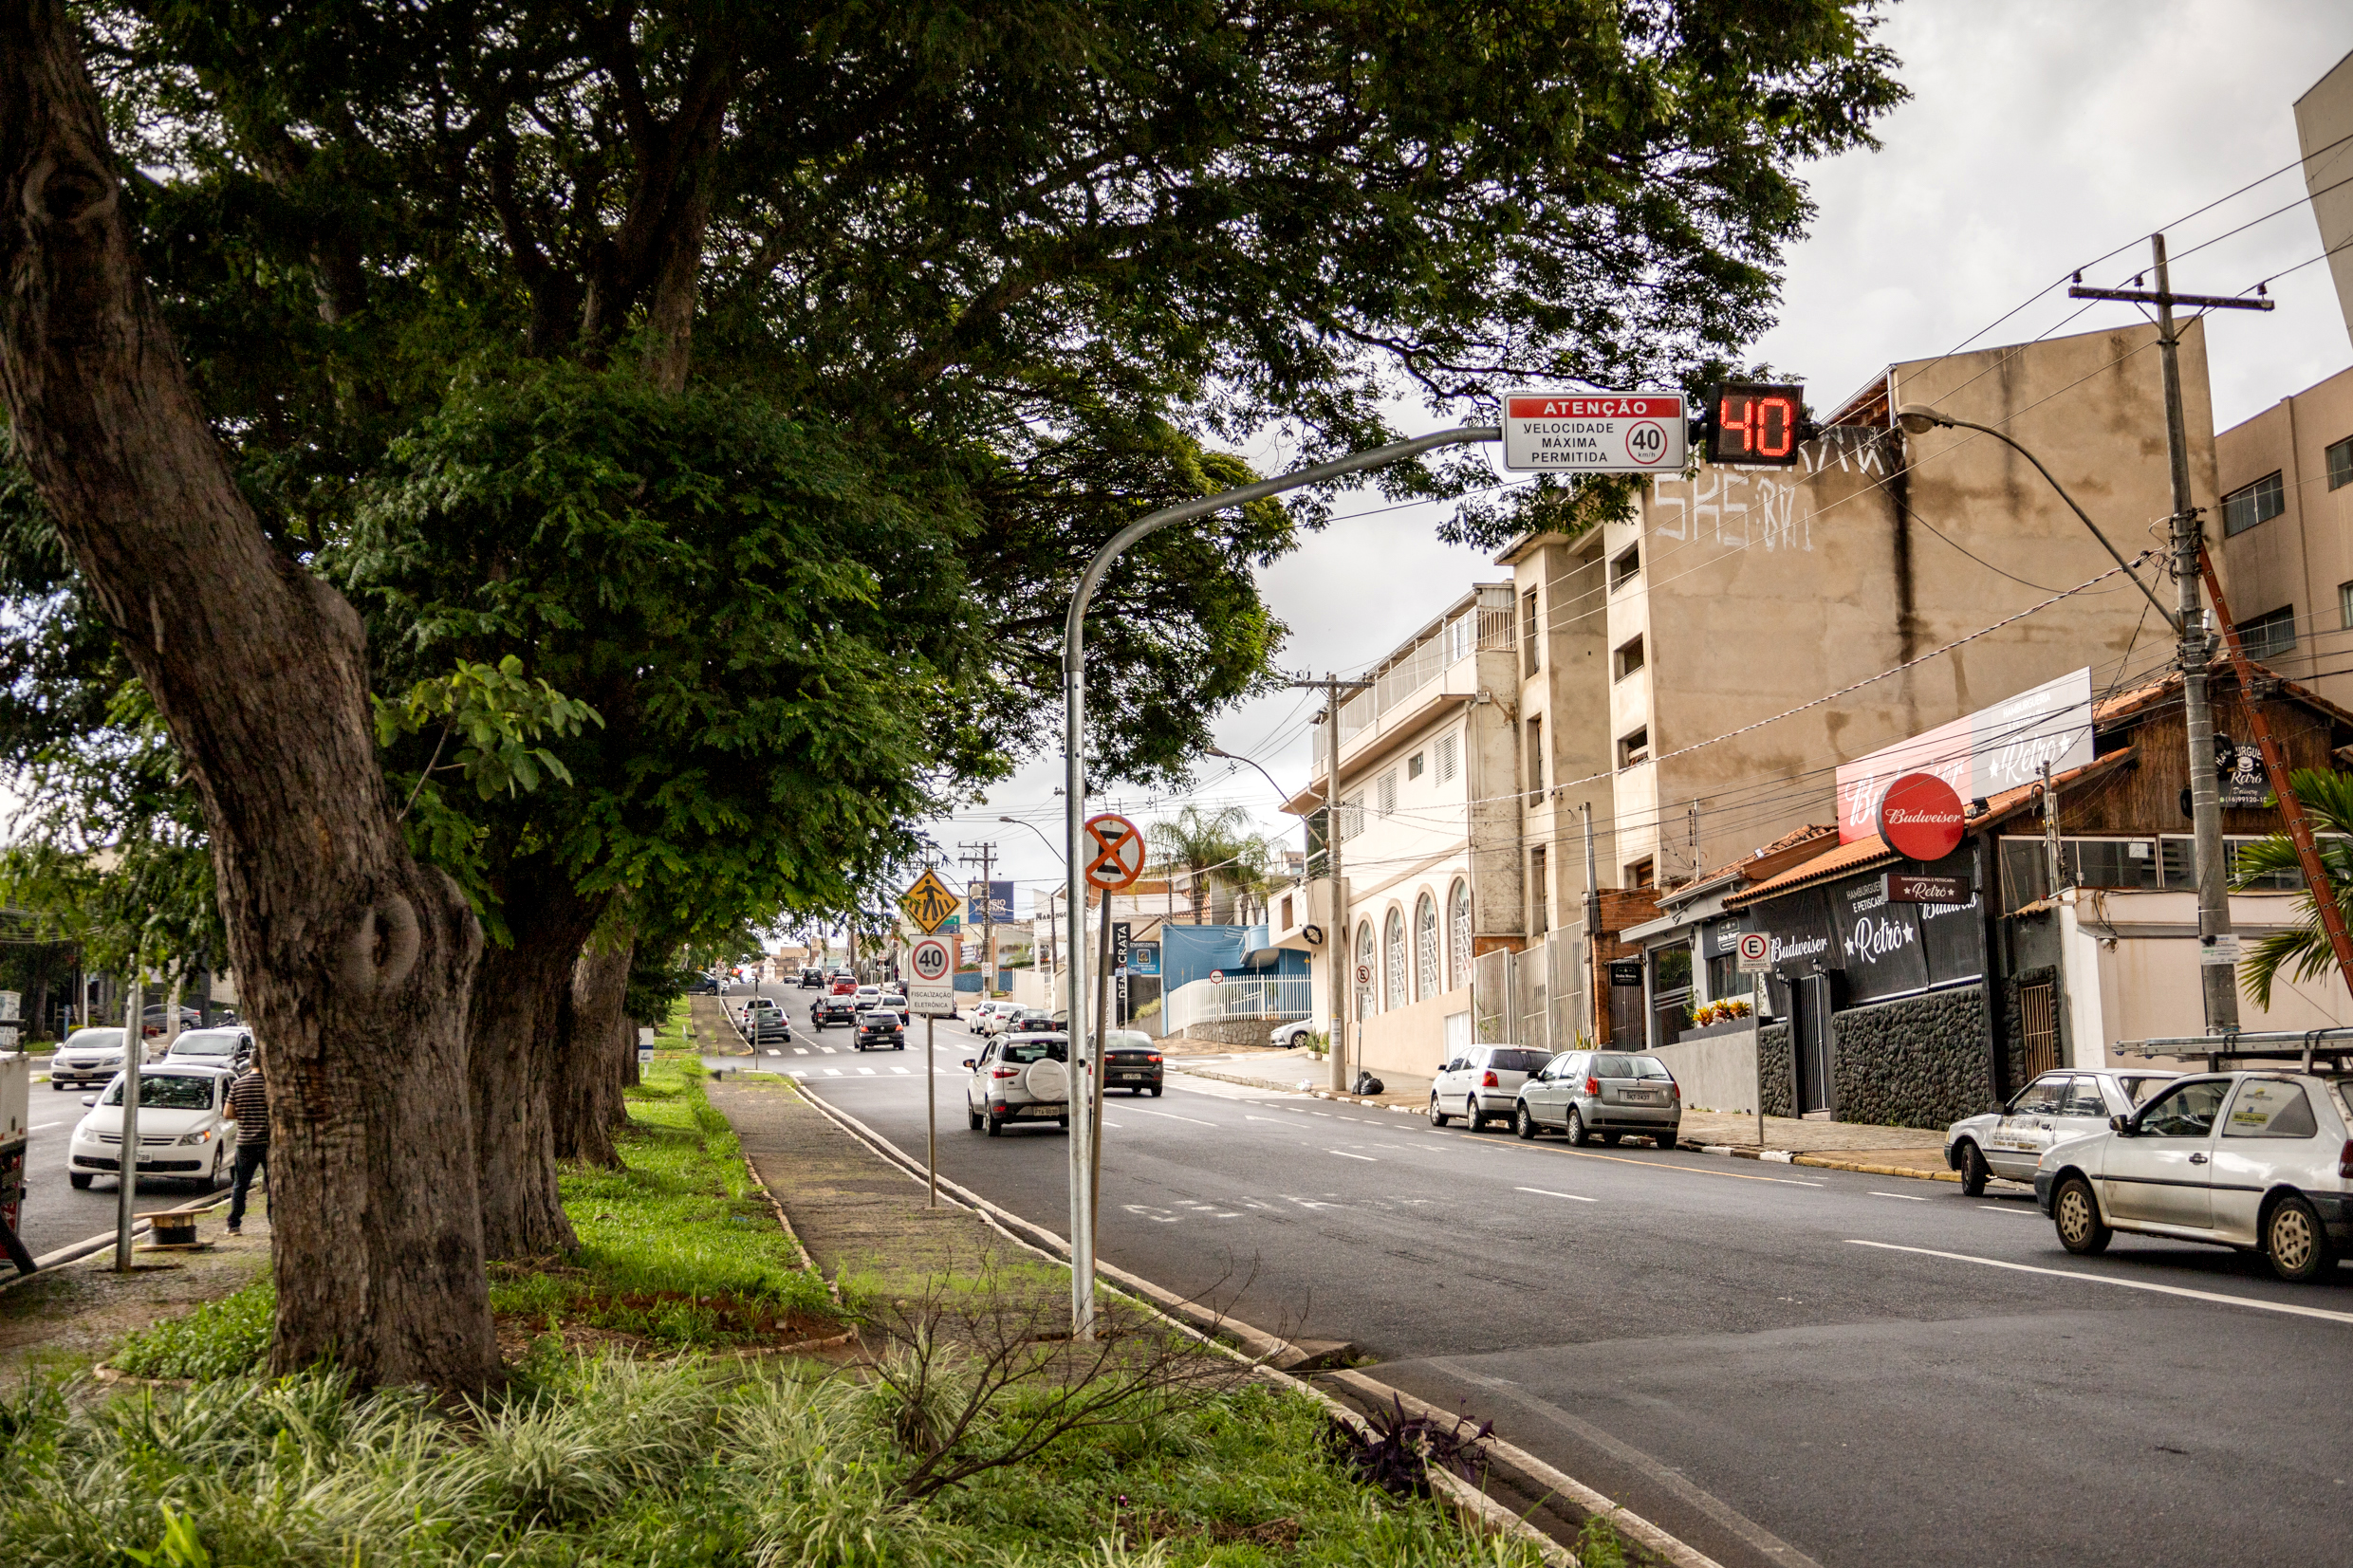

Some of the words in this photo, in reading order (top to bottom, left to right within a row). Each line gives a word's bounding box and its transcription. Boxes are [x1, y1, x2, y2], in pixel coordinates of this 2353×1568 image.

[1544, 399, 1647, 417] ATENÇÃO
[1524, 423, 1614, 434] VELOCIDADE
[1720, 397, 1791, 457] 40
[1542, 435, 1598, 448] MÁXIMA
[1632, 429, 1660, 451] 40
[1531, 452, 1607, 463] PERMITIDA
[2003, 692, 2051, 719] HAMBURGUERIA
[1997, 733, 2057, 784] Retrô
[1884, 808, 1961, 824] Budweiser
[1912, 882, 1947, 899] Retrô
[1749, 940, 1759, 953] E
[1769, 934, 1827, 964] Budweiser
[1855, 916, 1902, 964] Retrô
[918, 950, 942, 968] 40
